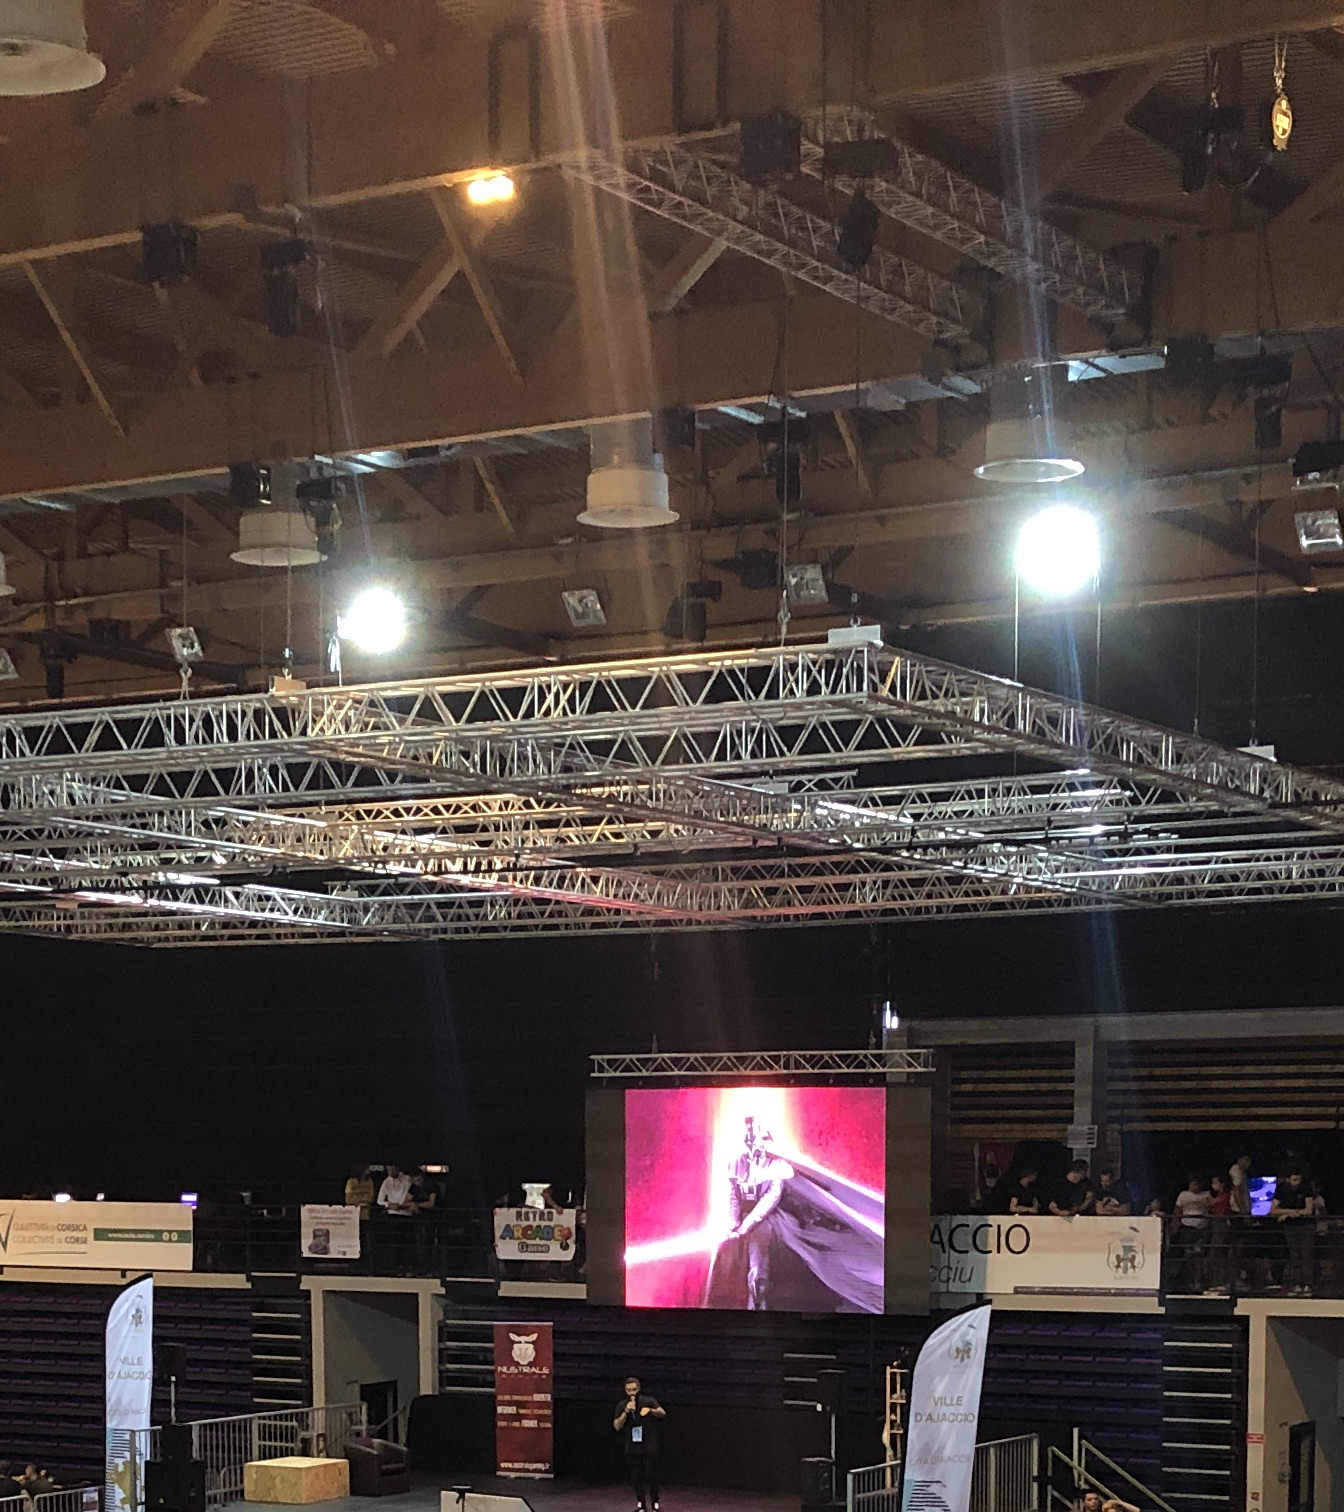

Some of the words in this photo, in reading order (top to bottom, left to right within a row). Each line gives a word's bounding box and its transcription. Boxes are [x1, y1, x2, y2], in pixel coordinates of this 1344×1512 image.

[516, 1210, 554, 1223] RETRO
[499, 1223, 565, 1242] ARCADE
[933, 1395, 964, 1407] VILLE
[914, 1411, 976, 1424] D'AJACCIO
